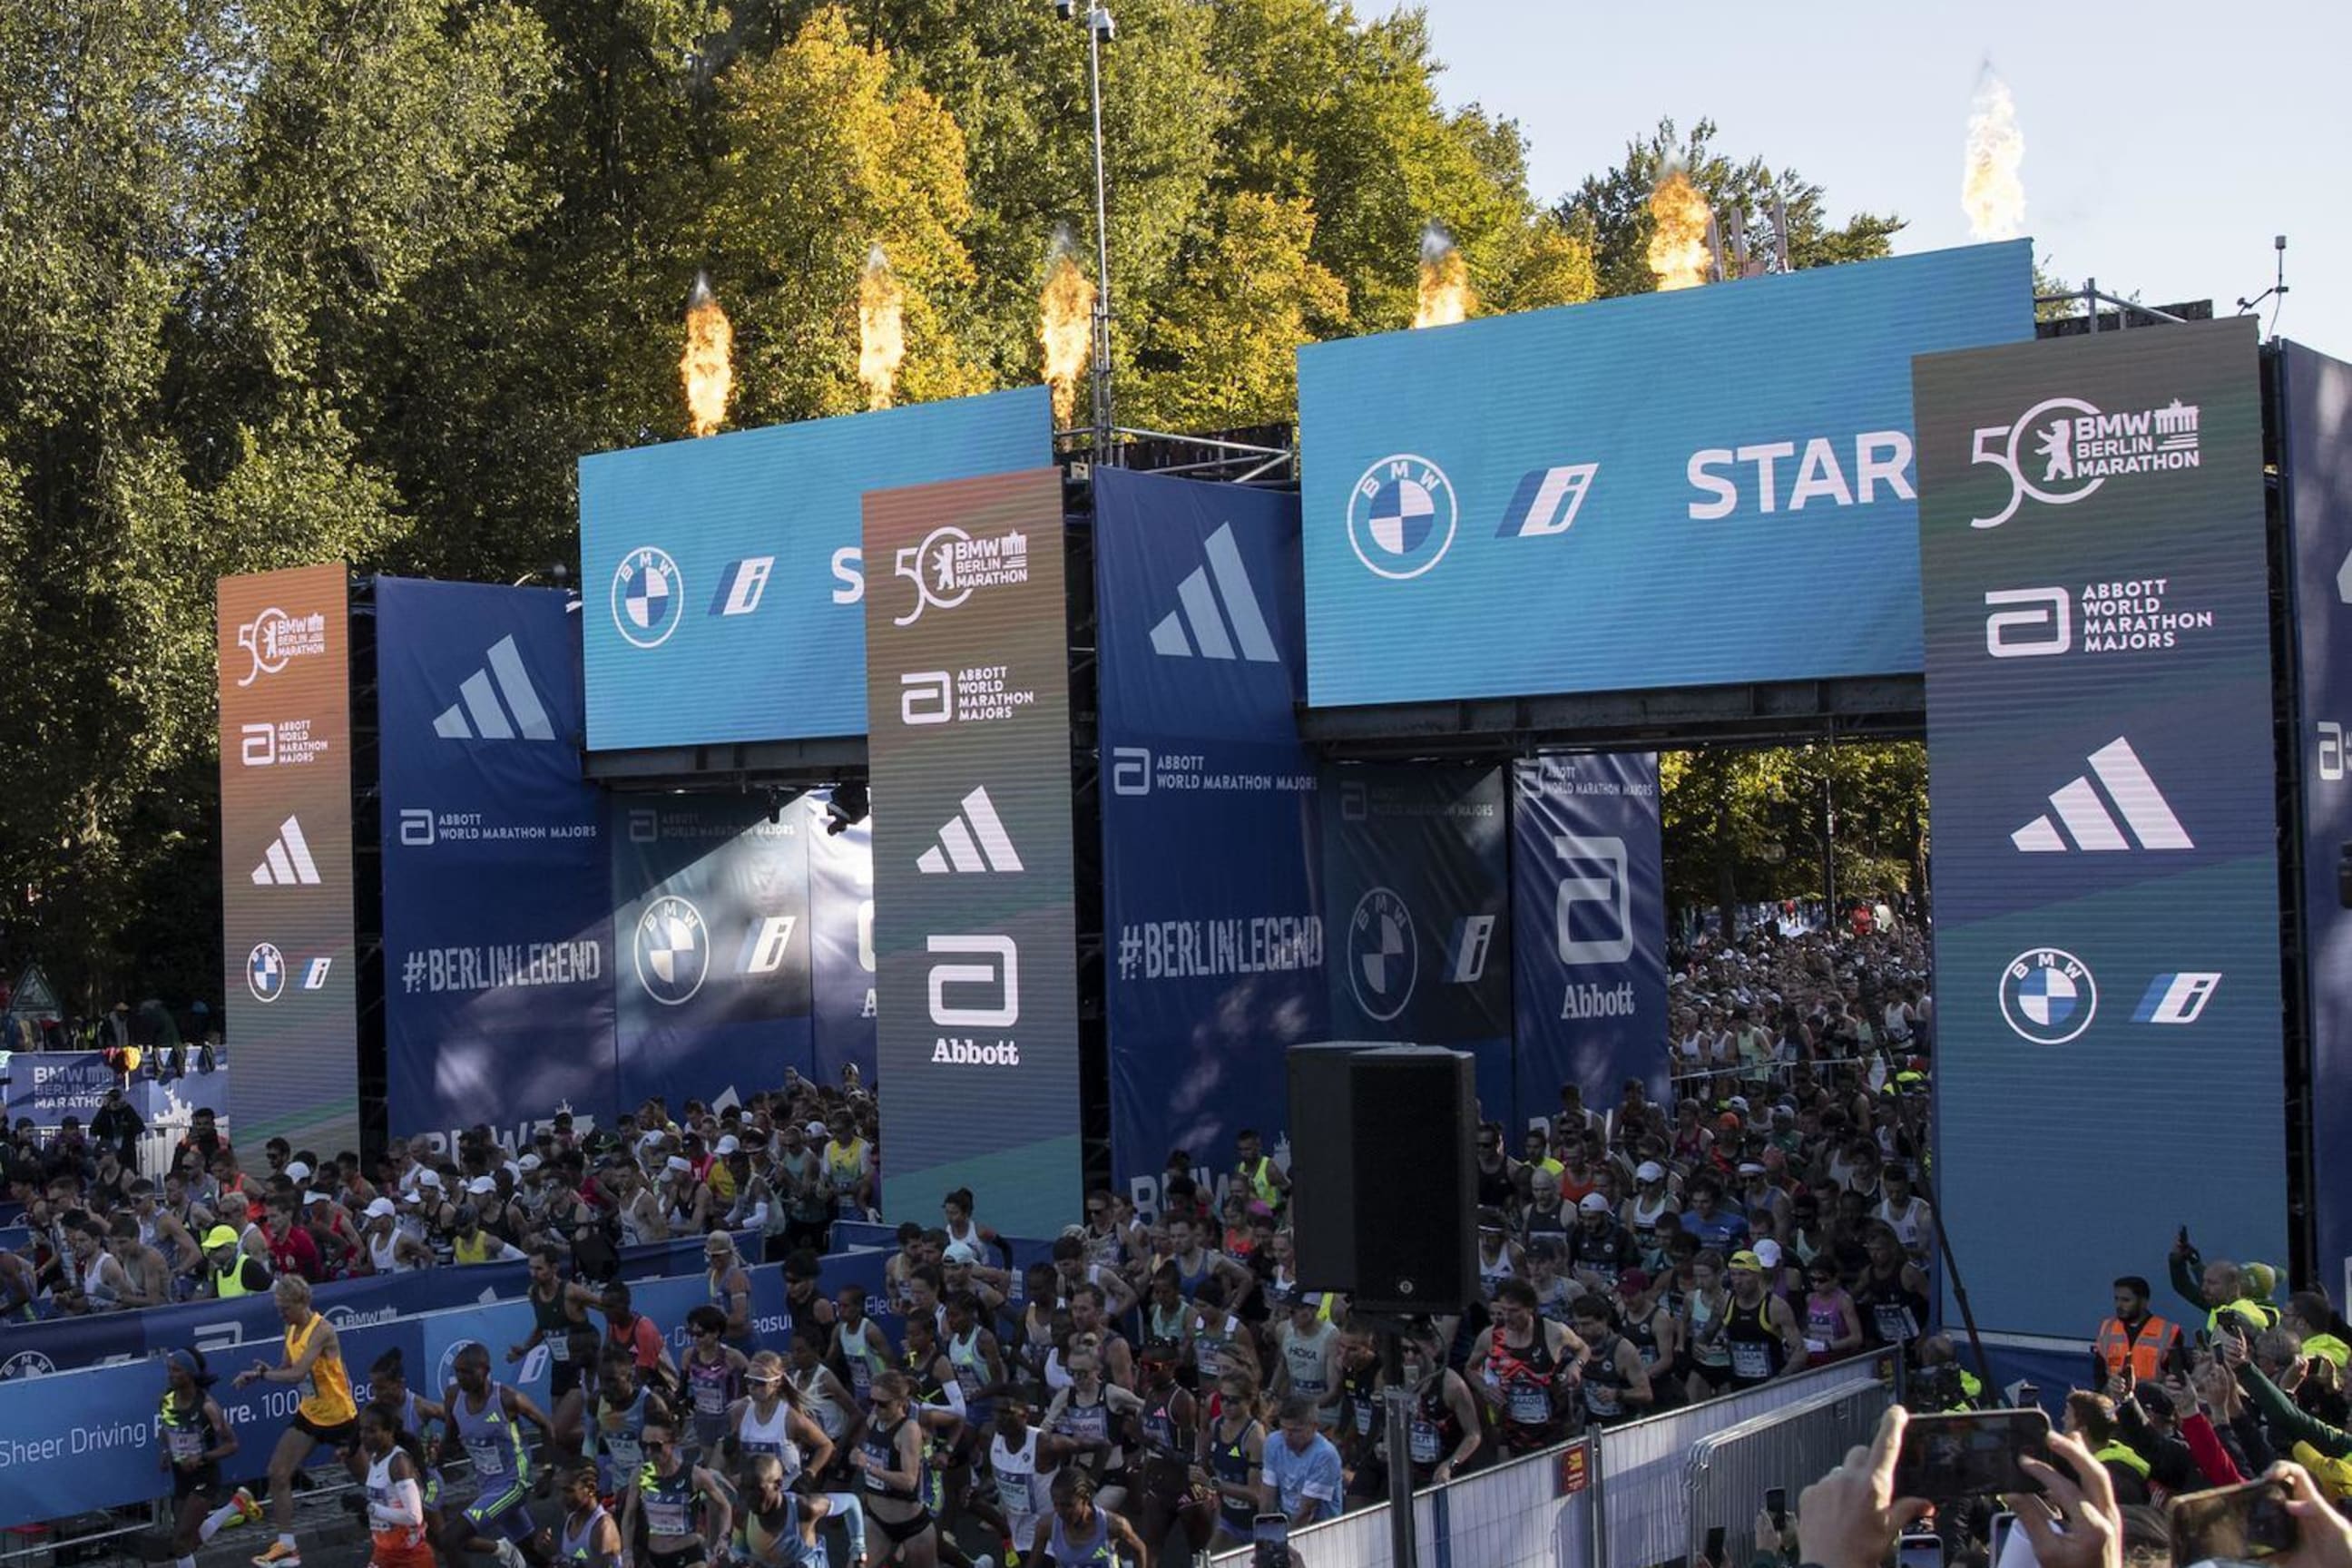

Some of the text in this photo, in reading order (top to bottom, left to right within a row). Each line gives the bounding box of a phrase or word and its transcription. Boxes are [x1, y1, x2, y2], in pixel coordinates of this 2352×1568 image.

[2075, 410, 2151, 442] BMW
[2076, 436, 2153, 459] BERLIN
[2076, 450, 2200, 478] MARATHON
[1686, 429, 1918, 521] STAR
[956, 538, 1001, 560] BMW
[956, 557, 1001, 573] BERLIN
[956, 569, 1027, 588] MARATHON
[2082, 579, 2168, 601] ABBOTT
[2082, 597, 2161, 617] WORLD
[278, 619, 307, 634] BMW
[2083, 611, 2212, 635] MARATHON
[278, 633, 308, 646] BERLIN
[2084, 631, 2175, 652] MAJORS
[278, 642, 324, 657] MARATHON
[958, 666, 1007, 681] ABBOTT
[958, 680, 1004, 694] WORLD
[958, 691, 1034, 708] MARATHON
[959, 707, 1012, 720] MAJORS
[279, 720, 310, 731] ABBOTT
[279, 730, 309, 741] WORLD
[279, 740, 328, 752] MARATHON
[279, 752, 314, 763] MAJORS
[1157, 756, 1204, 770] ABBOTT
[1157, 774, 1200, 789] WORLD
[1203, 776, 1271, 790] MARATHON
[1576, 783, 1621, 795] MARATHON
[439, 814, 481, 826] ABBOTT
[439, 826, 597, 839] WORLD MARATHON MAJORS
[756, 824, 795, 836] MAJORS
[1118, 915, 1324, 980] #BERLINLEGEND
[401, 940, 601, 993] #BERLINLEGEND
[1561, 981, 1635, 1020] Abbott
[931, 1038, 1020, 1065] Abbott
[34, 1065, 84, 1084] BMW
[34, 1083, 85, 1096] BERLIN
[34, 1095, 104, 1109] MARATHO
[0, 1437, 64, 1467] Sheer
[71, 1421, 147, 1454] Driving
[261, 1389, 300, 1419] 100
